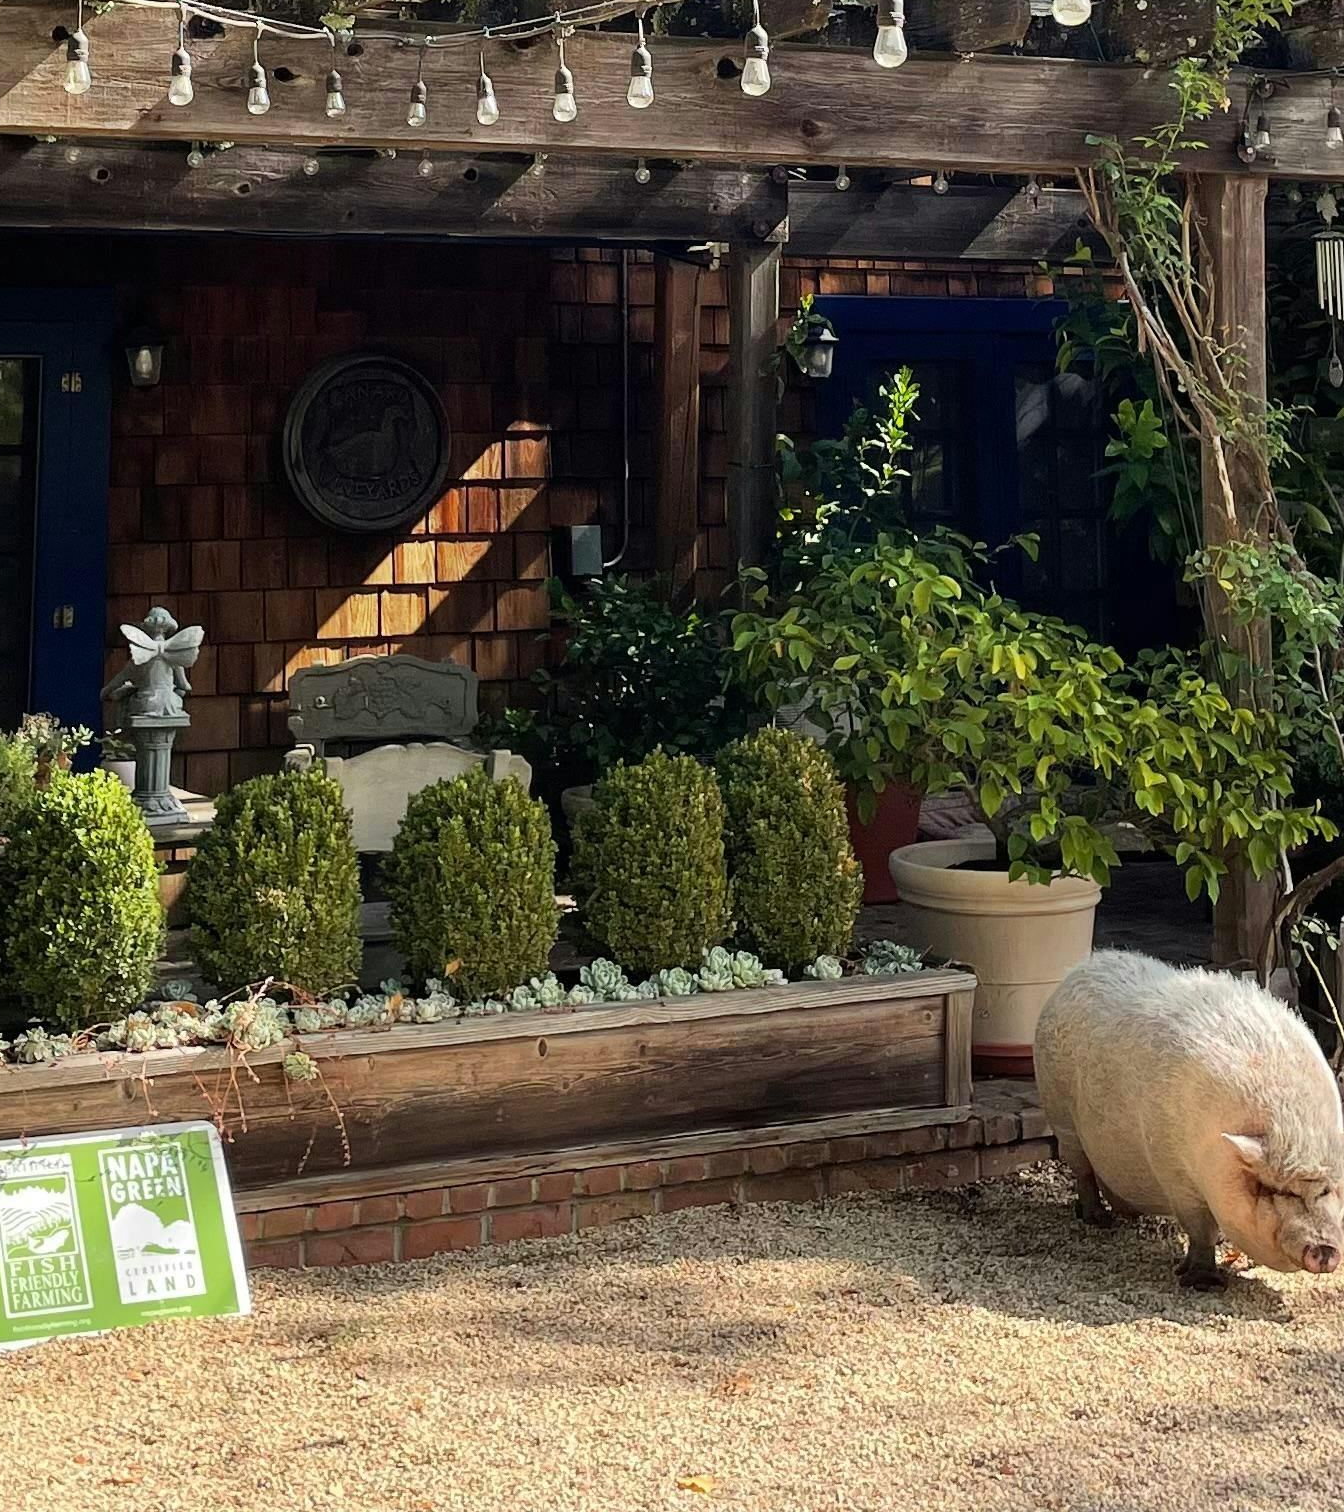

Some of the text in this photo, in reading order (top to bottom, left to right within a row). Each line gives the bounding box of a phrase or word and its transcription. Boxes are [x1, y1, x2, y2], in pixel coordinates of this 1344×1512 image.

[107, 1151, 177, 1181] NAPA
[111, 1176, 182, 1203] GREEN
[10, 1255, 77, 1277] FISH
[126, 1261, 193, 1277] CERTIFIED
[11, 1270, 78, 1293] FRIENDLY
[129, 1274, 196, 1296] LAND
[13, 1286, 83, 1310] FARMING
